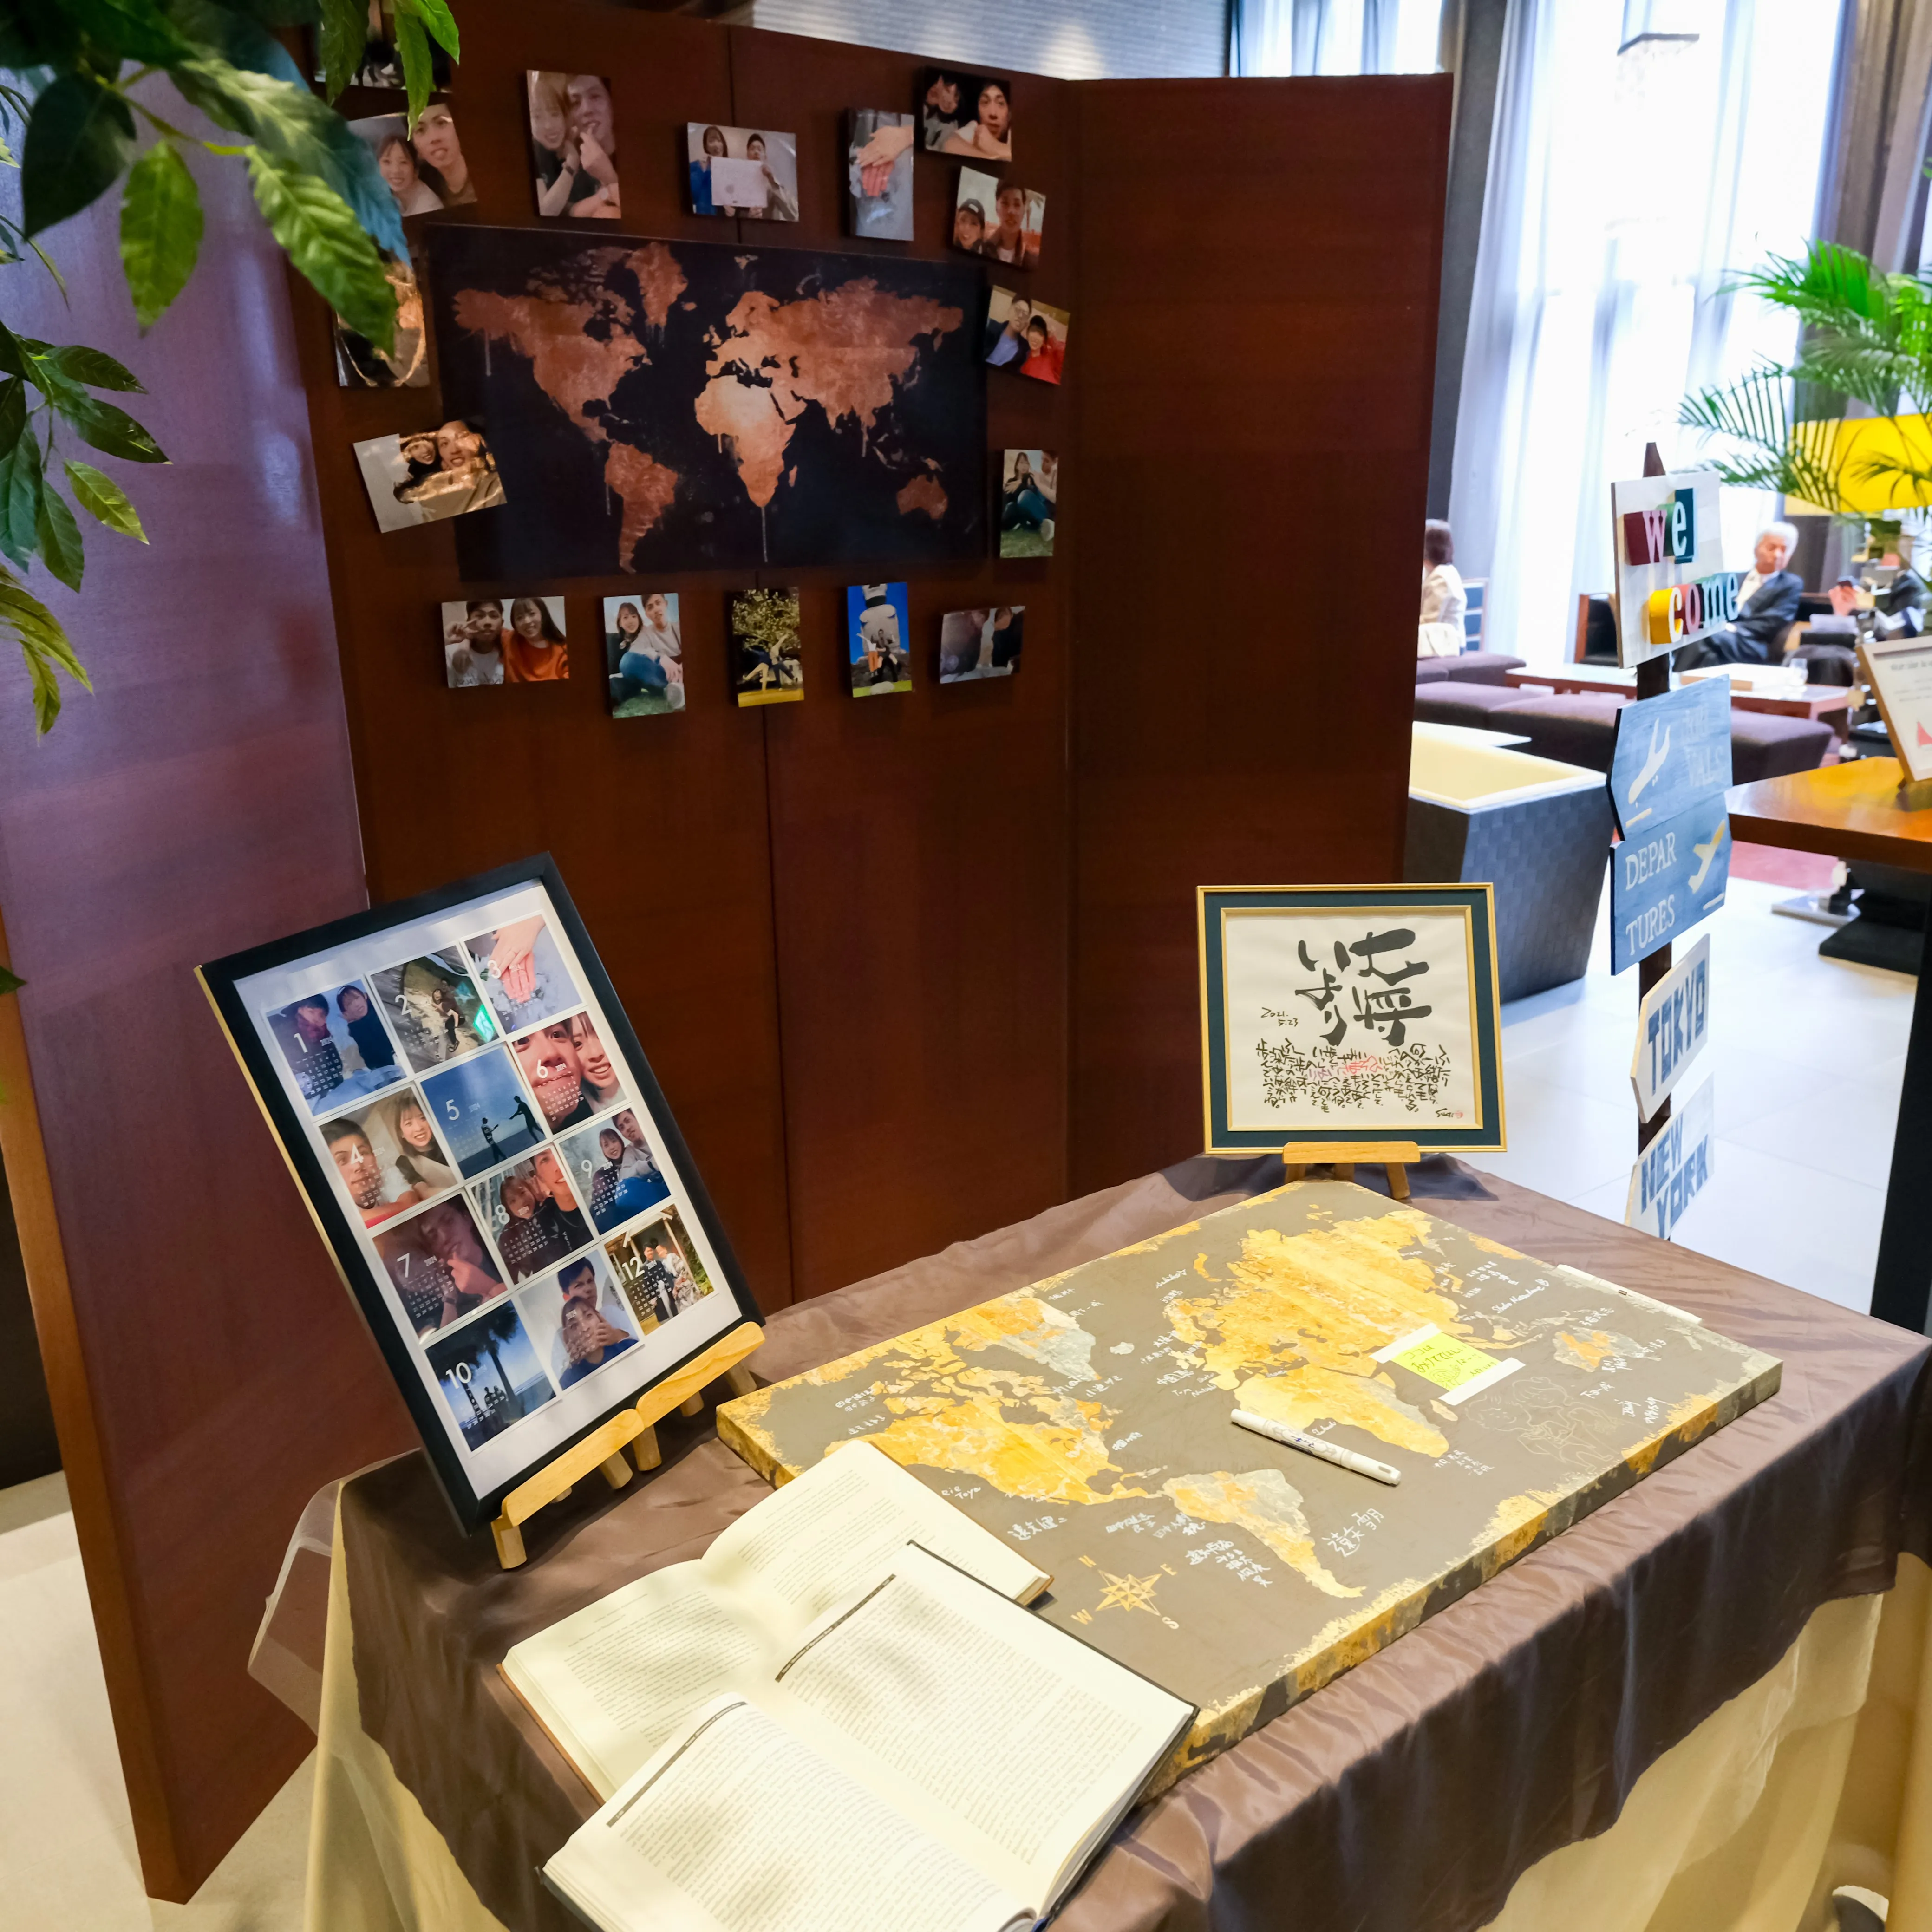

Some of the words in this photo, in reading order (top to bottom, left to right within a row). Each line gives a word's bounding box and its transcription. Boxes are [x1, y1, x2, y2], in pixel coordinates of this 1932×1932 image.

[1650, 573, 1739, 644] come
[1625, 831, 1677, 891] DEPAR
[1626, 894, 1676, 956] TURES
[487, 959, 502, 979] 3
[395, 994, 412, 1016] 2
[1647, 958, 1706, 1097] TOKYO
[294, 1032, 308, 1053] 1
[537, 1059, 548, 1078] 6
[446, 1099, 460, 1121] 5
[351, 1142, 363, 1165] 4
[1641, 1112, 1684, 1215] NEW
[581, 1159, 593, 1179] 9
[1656, 1133, 1710, 1239] YORK
[495, 1204, 510, 1225] 8
[397, 1253, 410, 1278] 7
[621, 1256, 646, 1280] 12
[445, 1361, 472, 1390] 10
[1078, 1555, 1097, 1568] N
[1160, 1563, 1177, 1576] E
[1070, 1609, 1093, 1625] W
[1162, 1616, 1179, 1630] S
